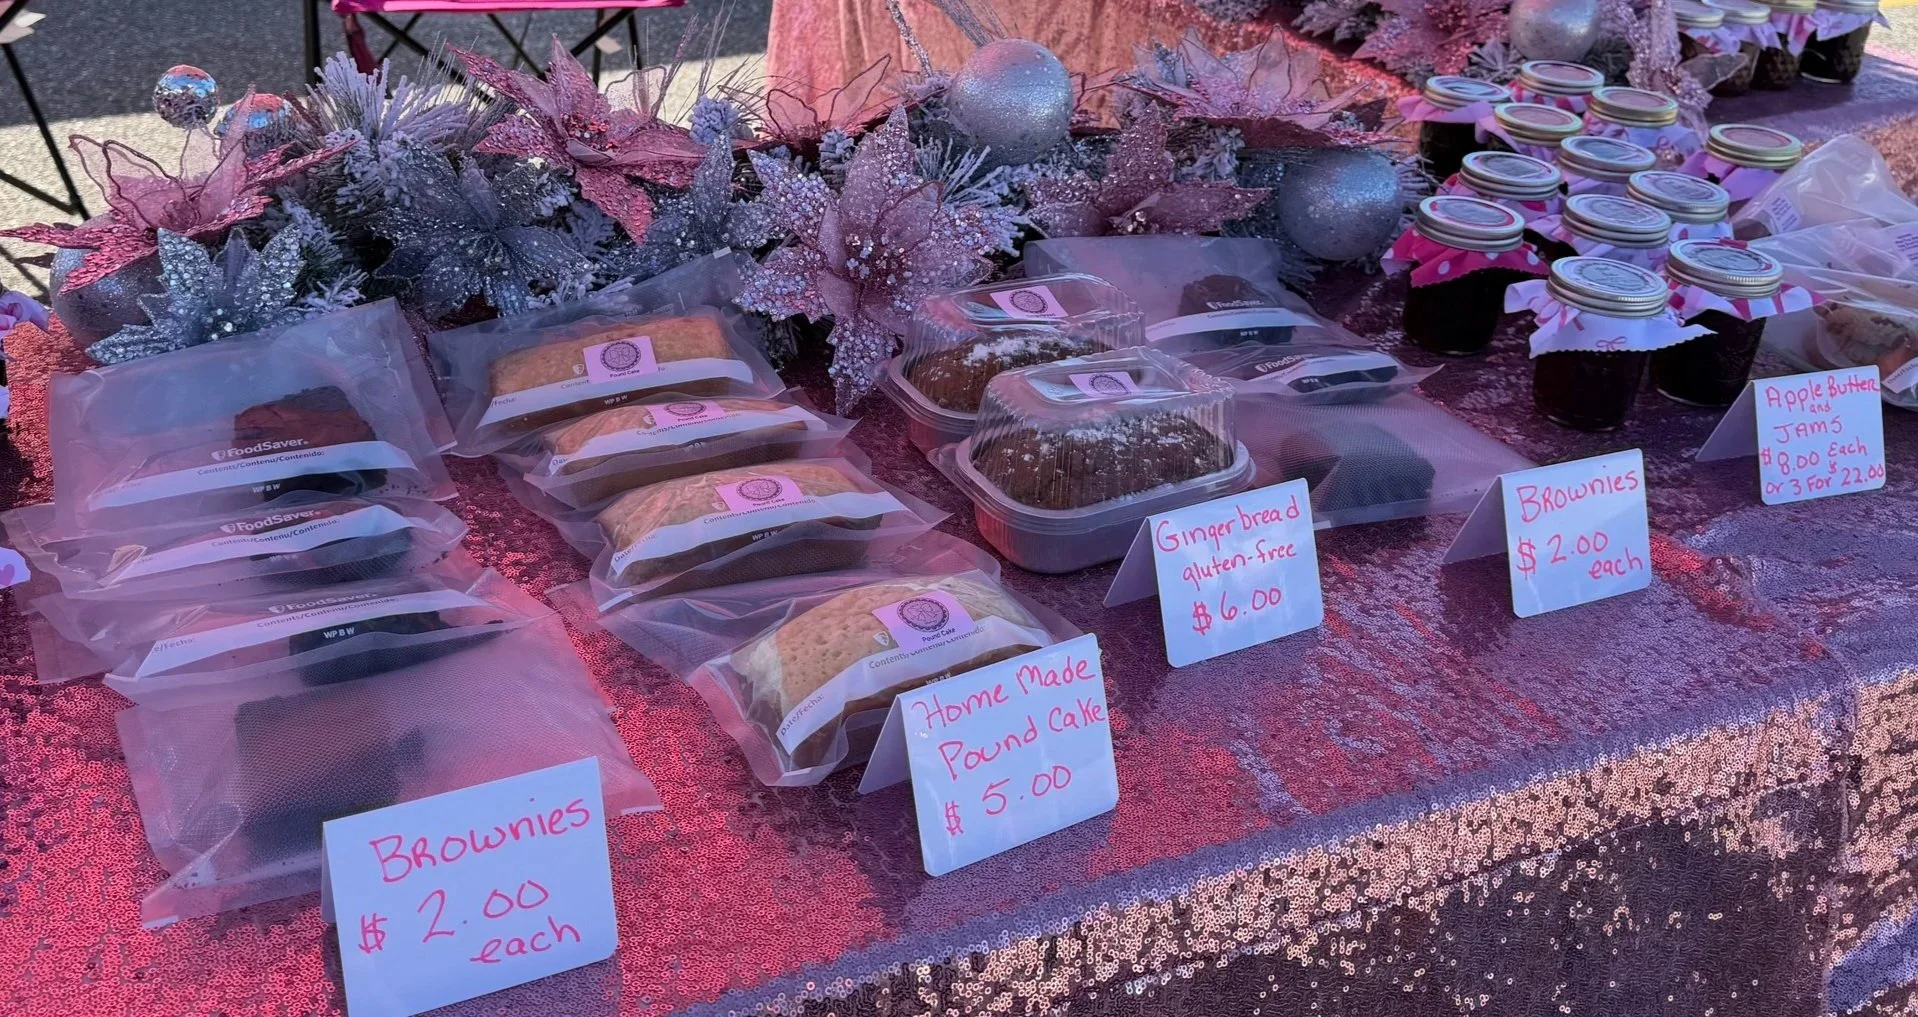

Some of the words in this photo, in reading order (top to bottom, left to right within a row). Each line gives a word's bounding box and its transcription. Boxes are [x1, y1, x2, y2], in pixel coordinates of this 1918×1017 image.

[1765, 380, 1823, 412] Apple
[1810, 400, 1831, 413] and
[227, 438, 305, 458] FoodSaver
[1790, 478, 1802, 496] 3
[236, 510, 315, 533] FoodSaver
[1182, 539, 1297, 591] gluten-free
[1516, 536, 1537, 580] $
[1547, 531, 1609, 564] 2.00
[1588, 547, 1643, 580] each
[286, 593, 371, 611] FoodSaver
[1220, 587, 1282, 621] 6.00
[324, 630, 338, 639] WP
[921, 632, 941, 643] Pound
[941, 627, 956, 637] Cake
[911, 684, 1009, 729] Home
[1016, 656, 1096, 695] Made
[938, 715, 1038, 781] Pound
[981, 765, 1072, 815] 5.00
[417, 880, 549, 943] 2.00
[470, 916, 581, 963] each
